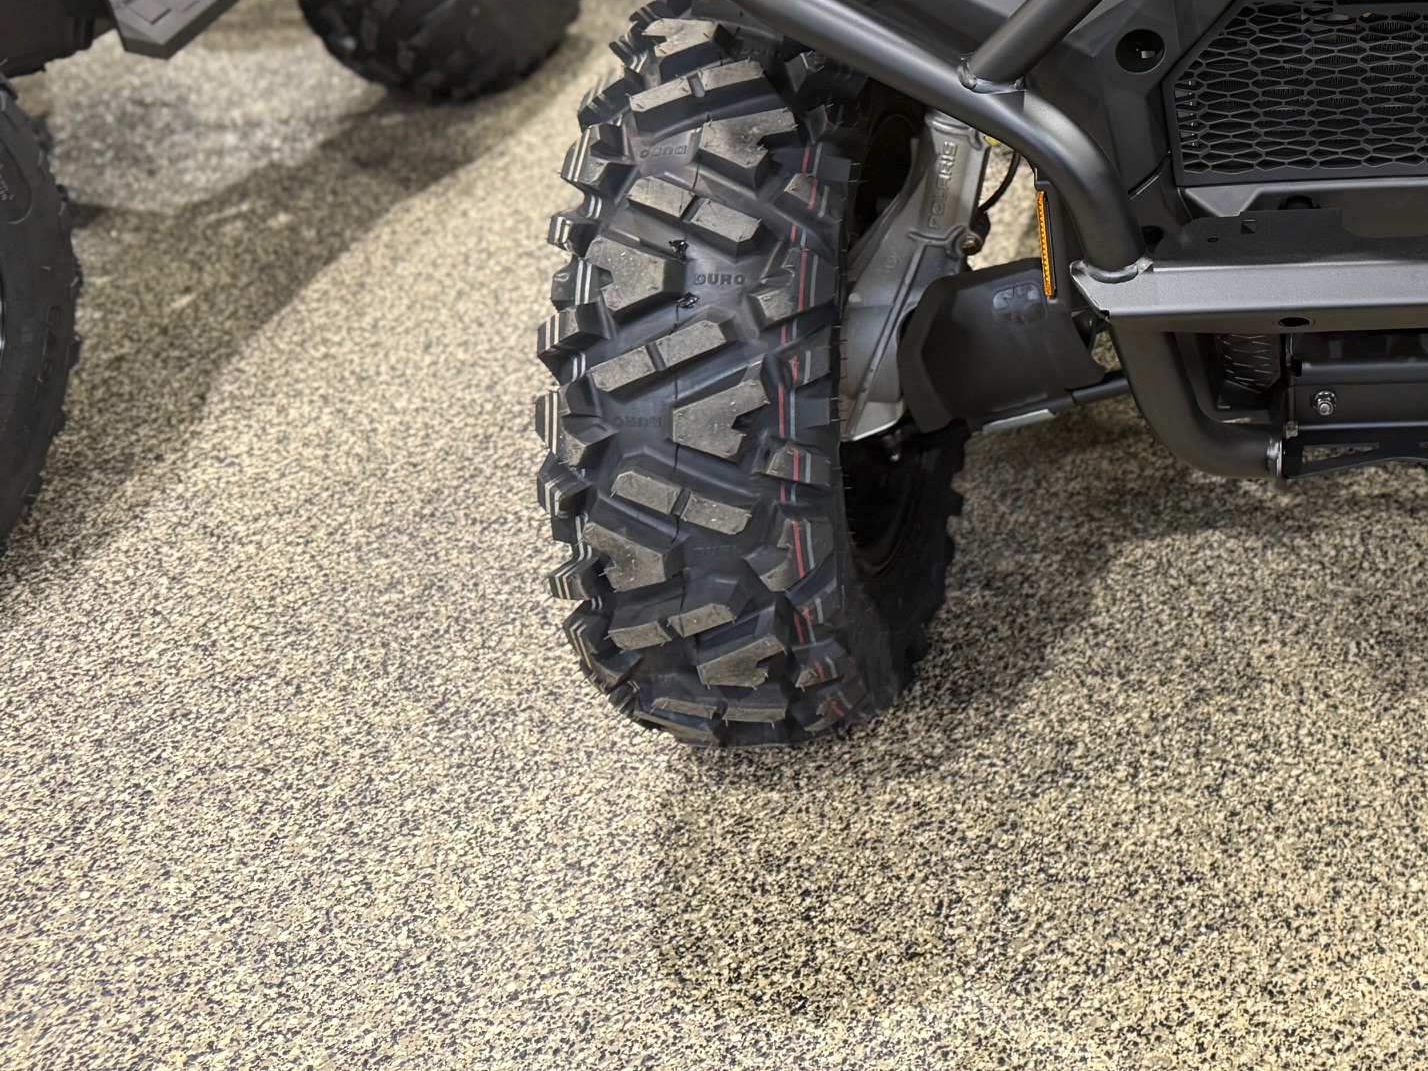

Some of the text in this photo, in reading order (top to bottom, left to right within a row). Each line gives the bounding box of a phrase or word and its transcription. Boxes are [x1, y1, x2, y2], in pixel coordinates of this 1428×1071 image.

[640, 145, 687, 159] DURO
[928, 141, 957, 229] POLARIS
[694, 273, 745, 285] DURO
